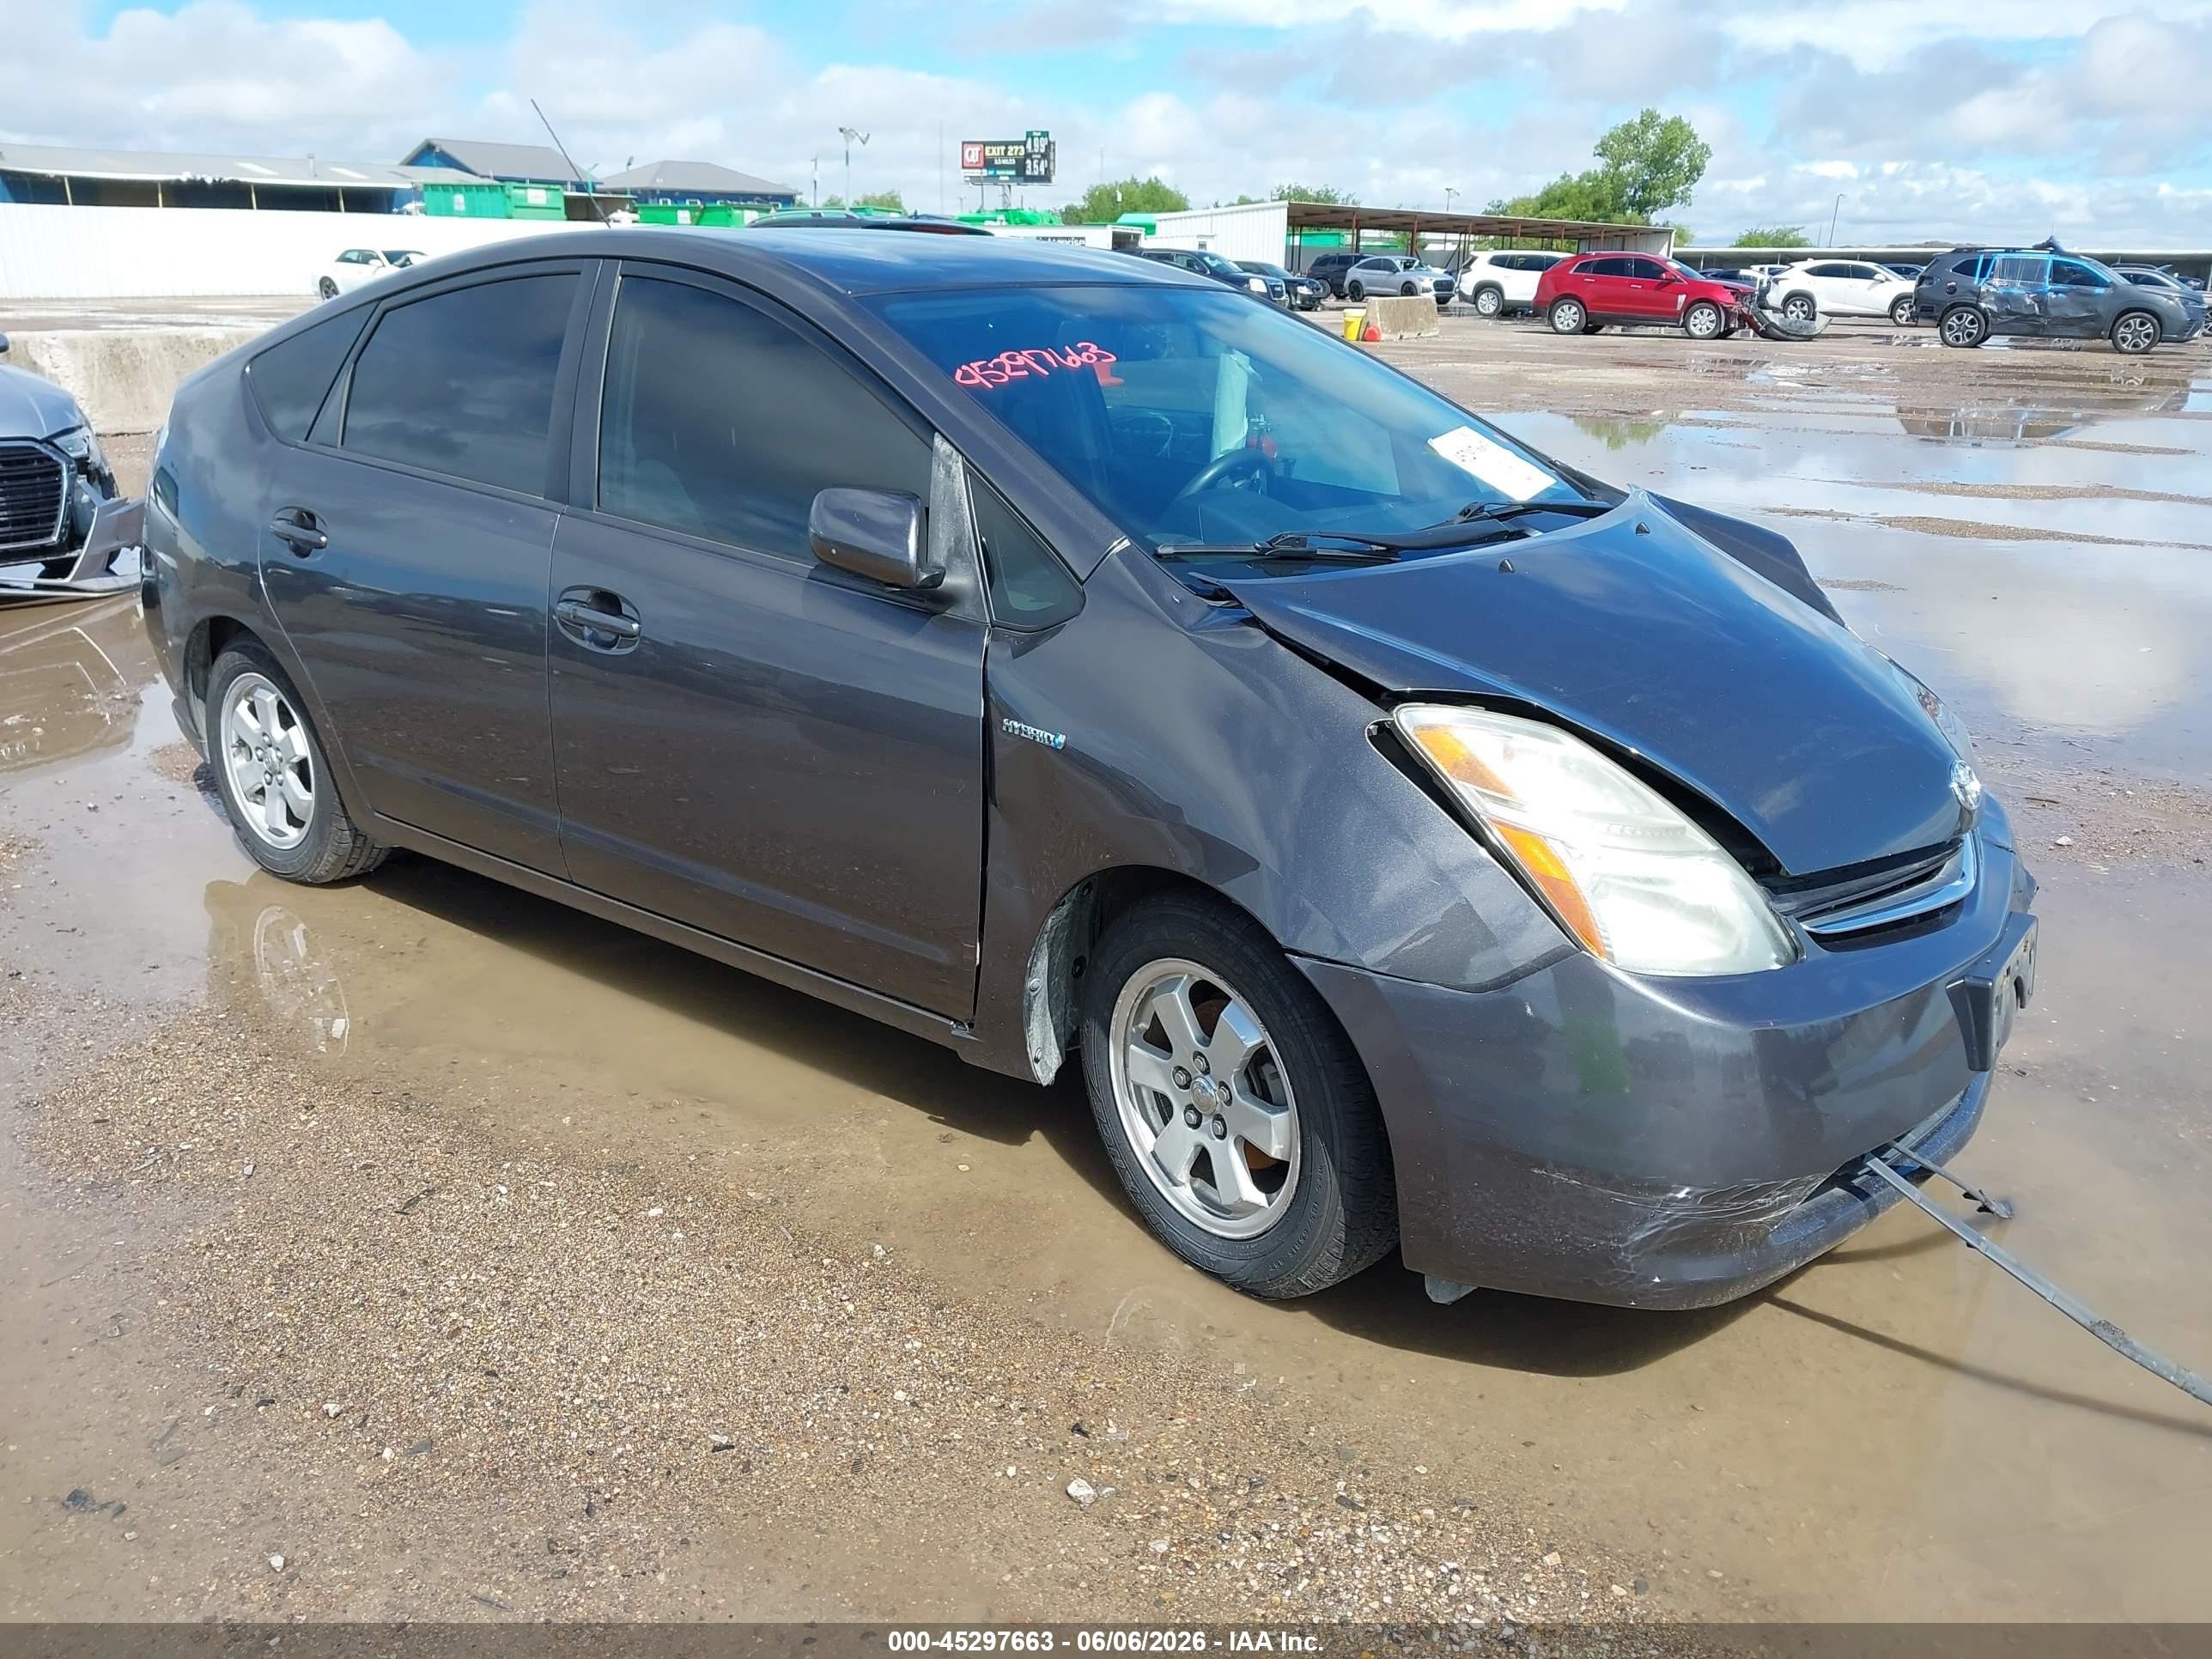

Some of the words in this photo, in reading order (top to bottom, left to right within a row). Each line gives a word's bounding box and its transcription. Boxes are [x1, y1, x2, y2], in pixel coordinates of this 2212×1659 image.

[965, 147, 981, 164] QT
[985, 145, 1006, 156] EXIT
[1007, 145, 1024, 156] 273
